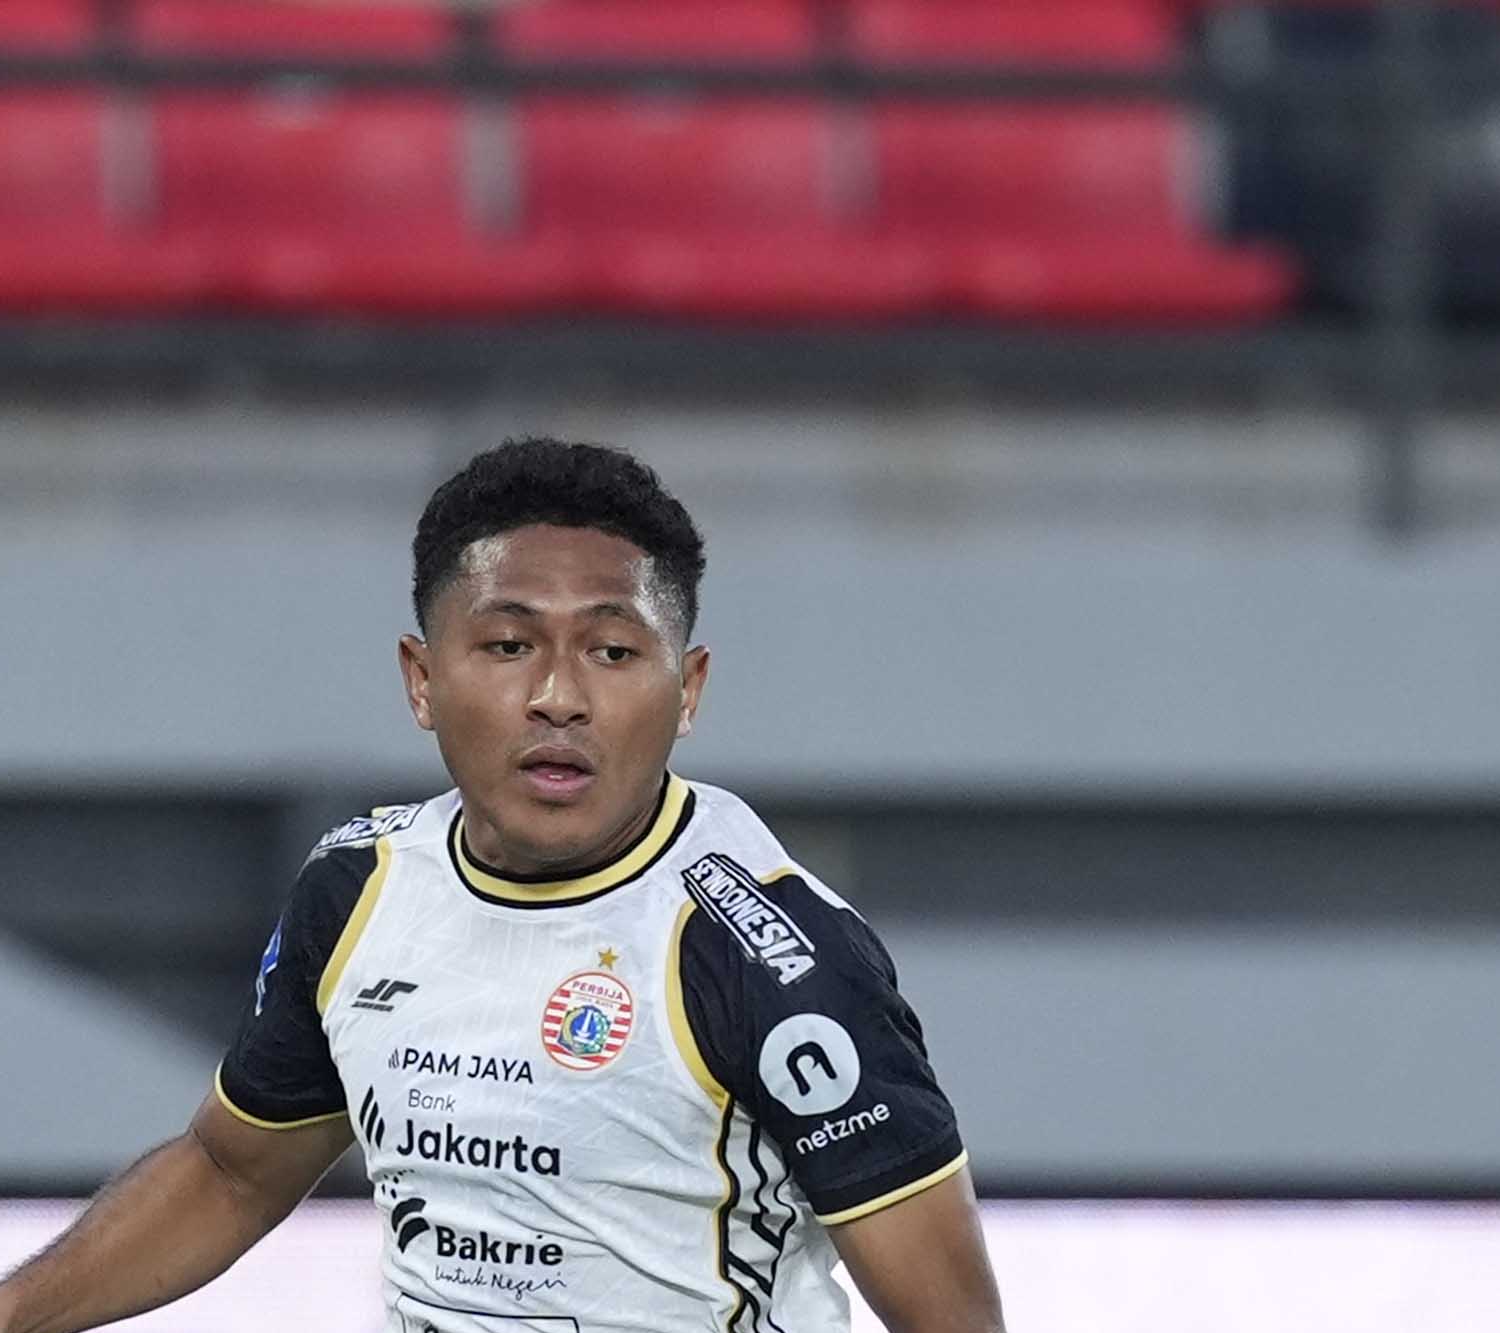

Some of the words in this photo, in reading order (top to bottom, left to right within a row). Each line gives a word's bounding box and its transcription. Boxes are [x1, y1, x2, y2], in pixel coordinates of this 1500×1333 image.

[402, 1048, 461, 1077] PAM
[467, 1055, 534, 1084] JAYA
[408, 1088, 457, 1113] Bank
[397, 1119, 561, 1177] Jakarta
[796, 1102, 891, 1156] netzme
[435, 1224, 564, 1266] Bakrie
